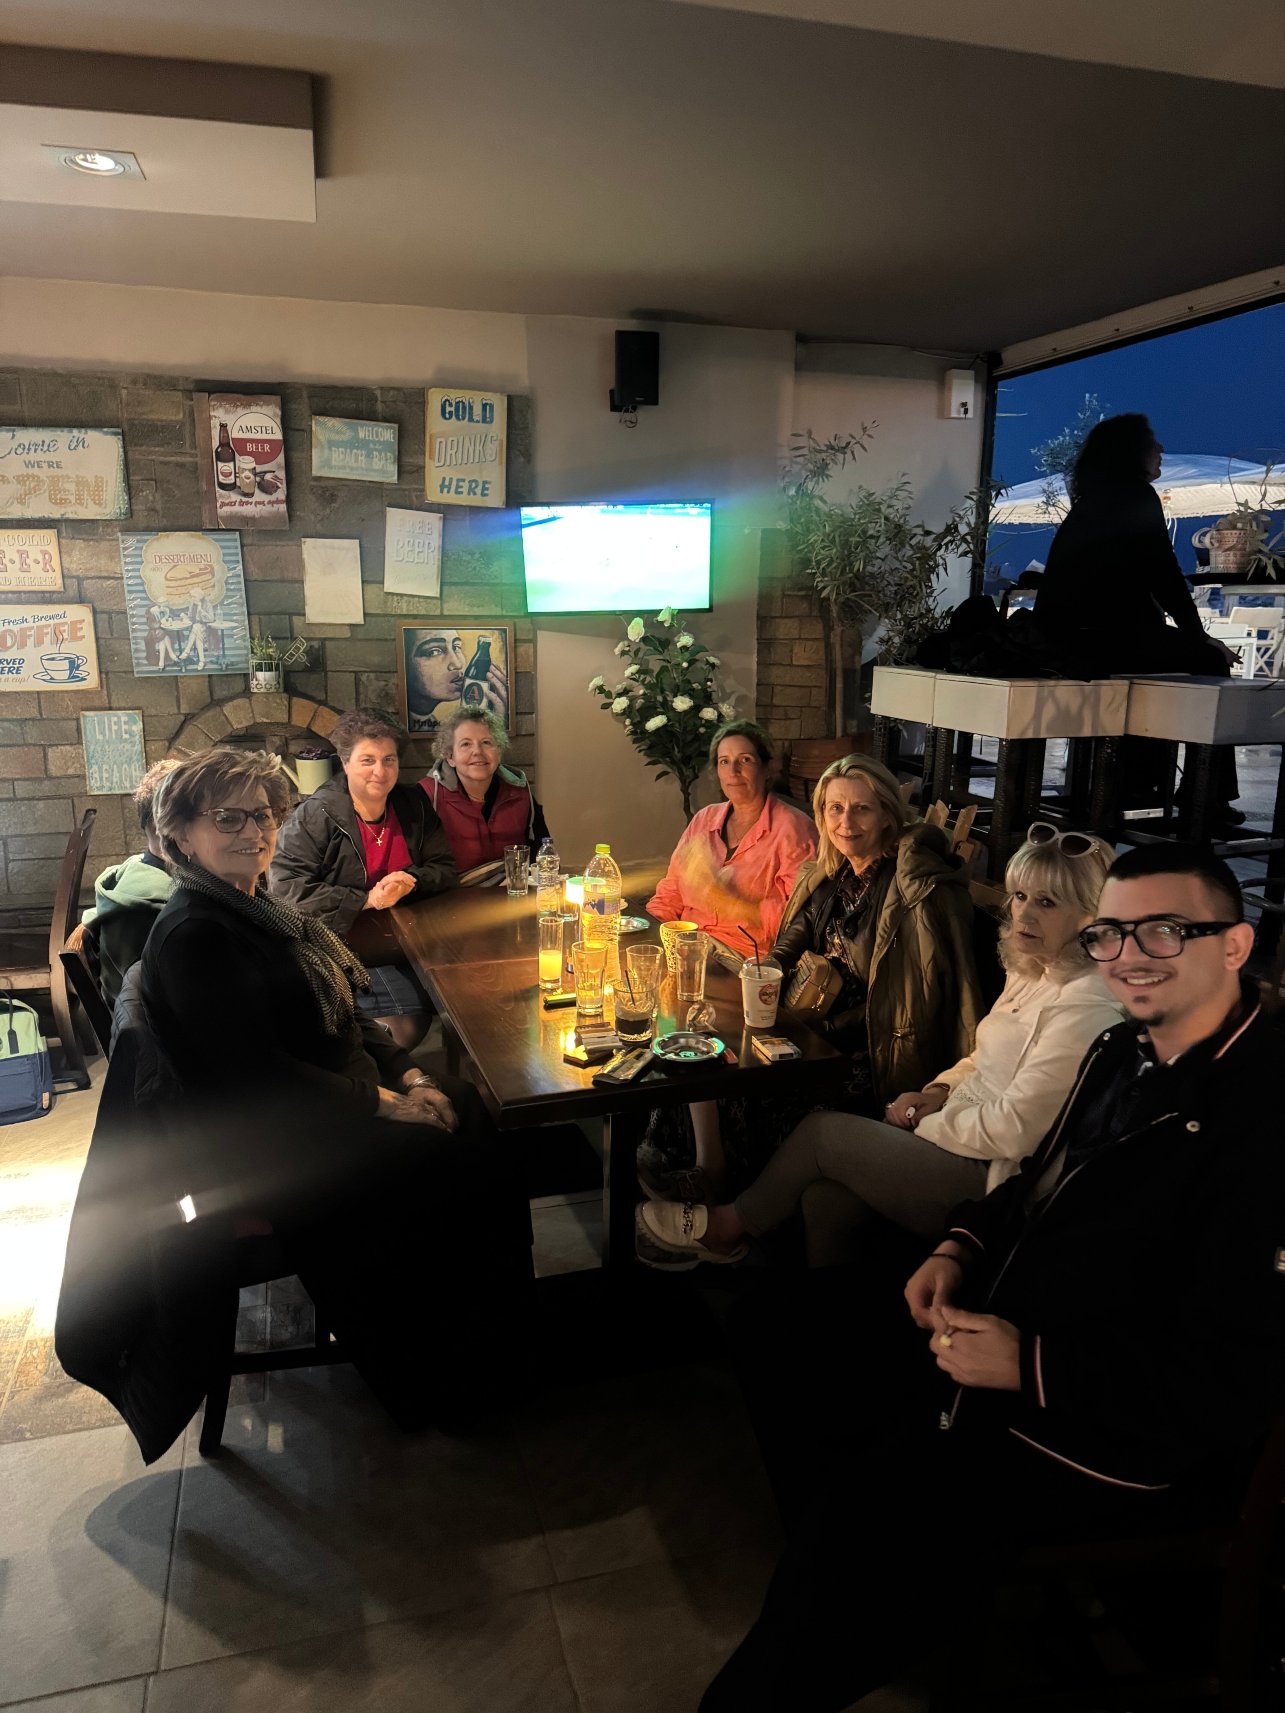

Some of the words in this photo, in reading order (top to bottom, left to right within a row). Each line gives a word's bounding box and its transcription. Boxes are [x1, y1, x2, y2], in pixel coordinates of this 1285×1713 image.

[440, 394, 495, 425] COLD
[237, 425, 276, 435] AMSTEL
[357, 425, 395, 442] WELCOME
[67, 436, 90, 451] in
[246, 443, 271, 453] BEER
[434, 432, 498, 468] DRINKS
[24, 460, 63, 469] WE'RE
[439, 476, 492, 497] HERE
[1, 616, 30, 627] Fresh
[31, 610, 67, 624] Brewed
[94, 716, 130, 740] LIFE
